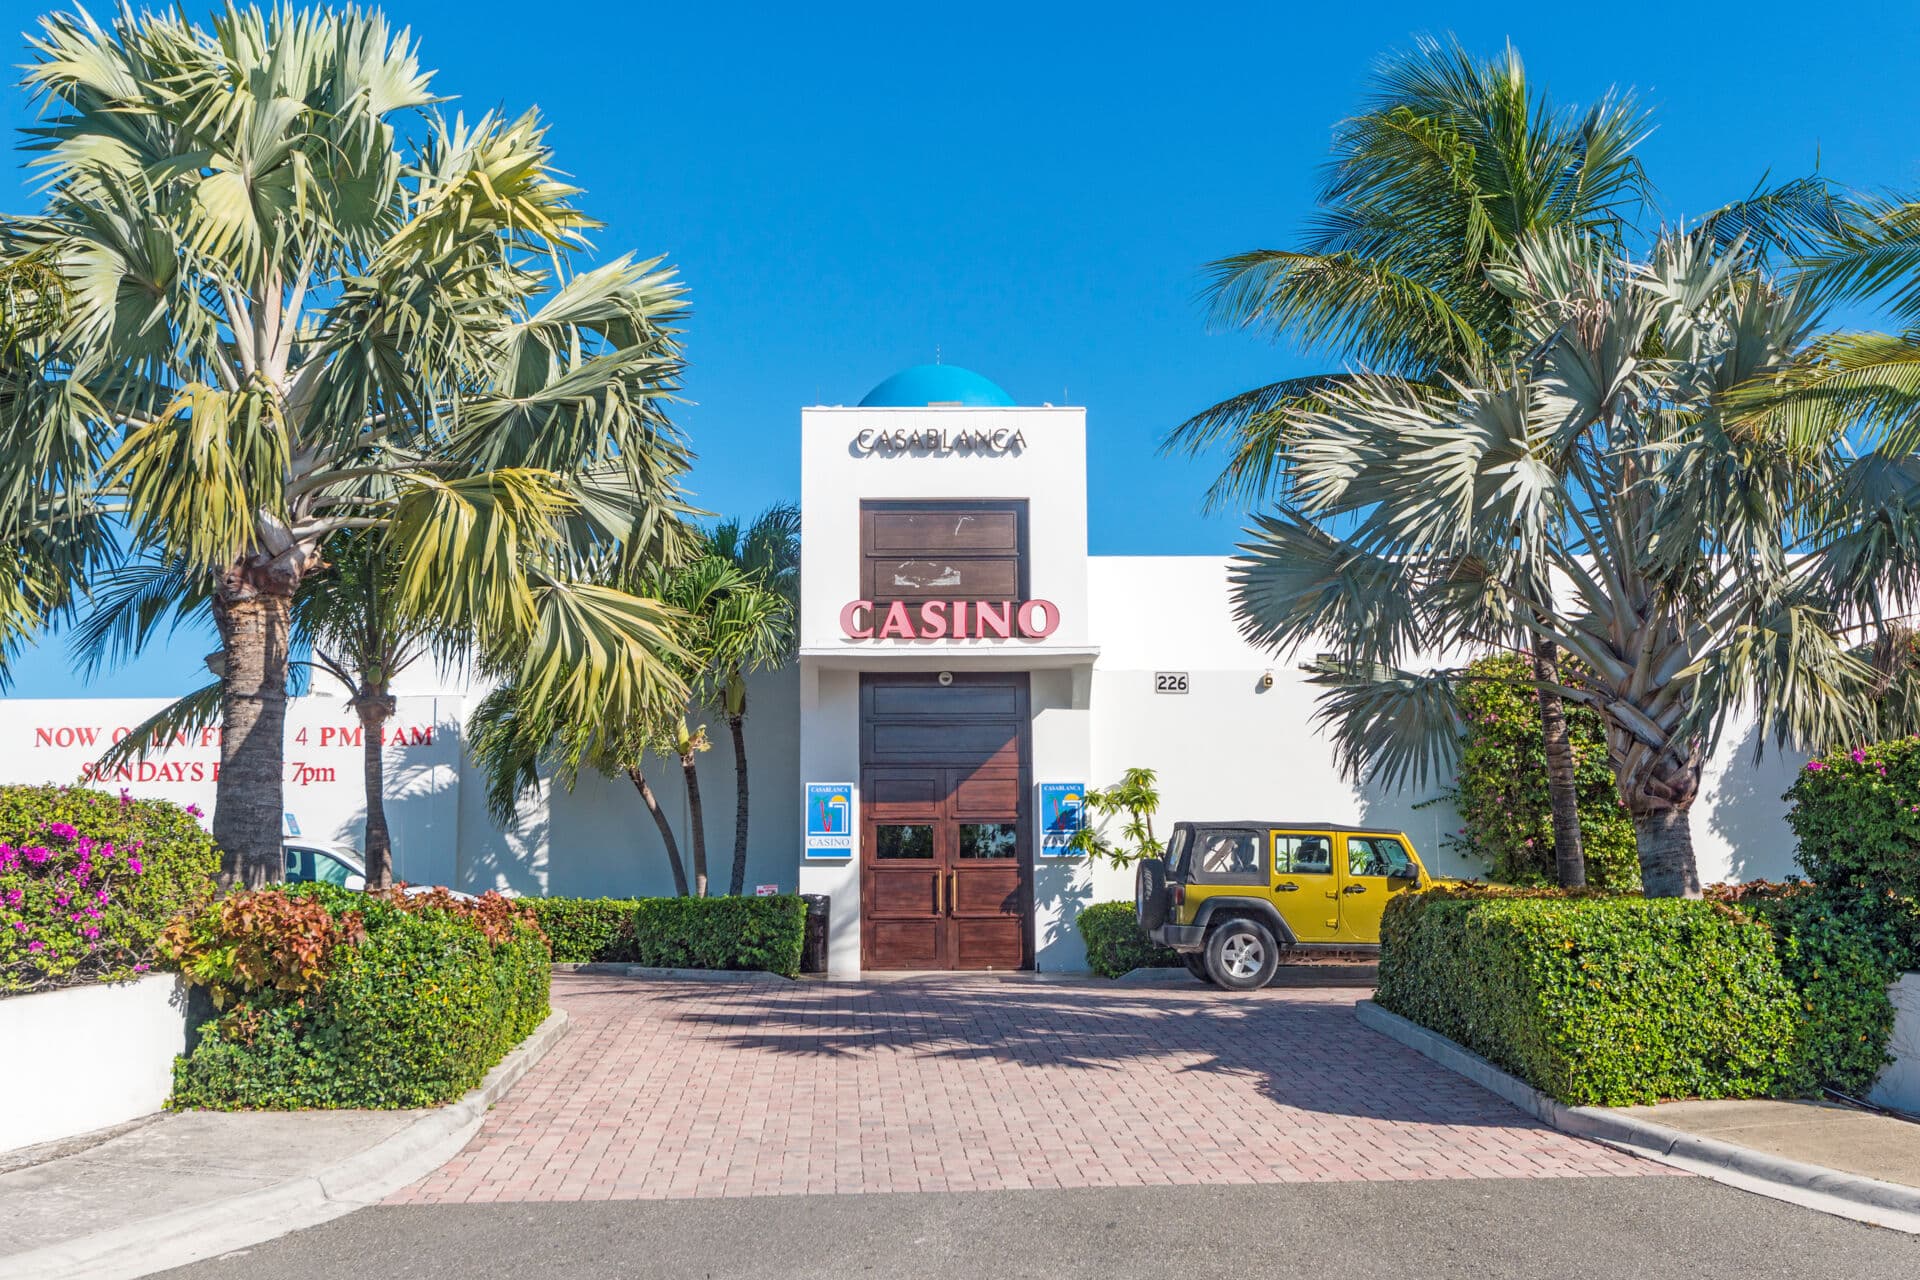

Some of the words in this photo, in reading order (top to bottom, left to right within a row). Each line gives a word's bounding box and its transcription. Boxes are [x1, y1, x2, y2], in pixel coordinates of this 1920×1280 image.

[857, 428, 1027, 450] CASABLANCA
[839, 598, 1060, 640] CASINO
[1157, 675, 1187, 690] 226
[35, 727, 101, 748] NOW
[295, 727, 308, 746] 4
[319, 727, 362, 747] PM
[81, 762, 204, 782] SUNDAYS
[291, 762, 336, 786] 7pm
[808, 838, 850, 847] CASINO
